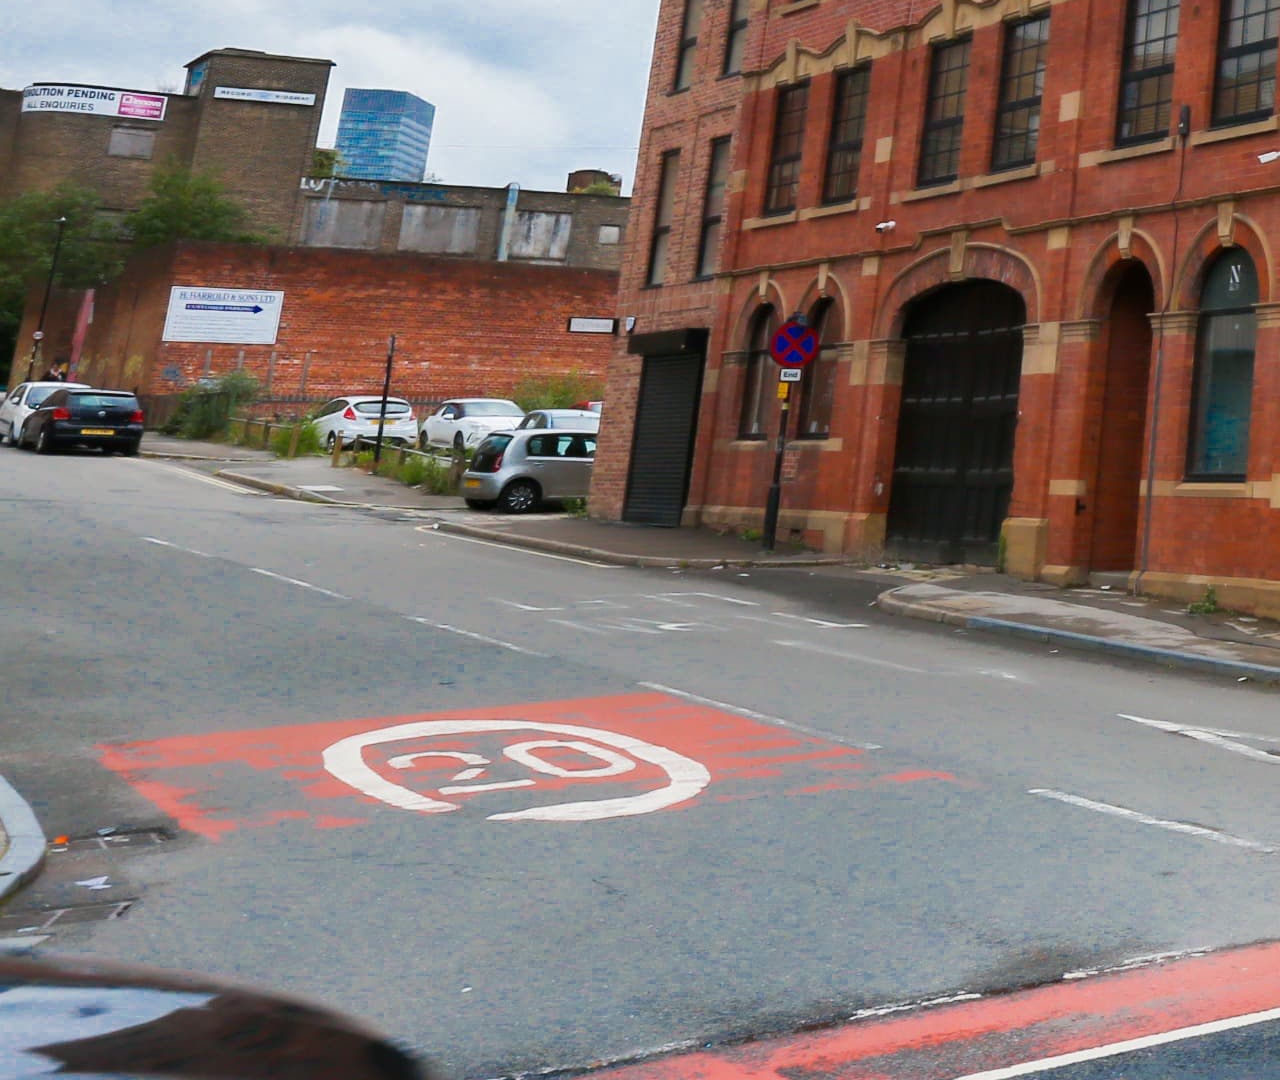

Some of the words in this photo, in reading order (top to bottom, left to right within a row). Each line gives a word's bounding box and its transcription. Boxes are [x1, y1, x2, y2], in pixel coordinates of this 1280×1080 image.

[24, 87, 64, 97] OLITION
[67, 88, 116, 101] PENDING
[40, 100, 94, 111] ENQUIRIES
[1229, 264, 1241, 283] N
